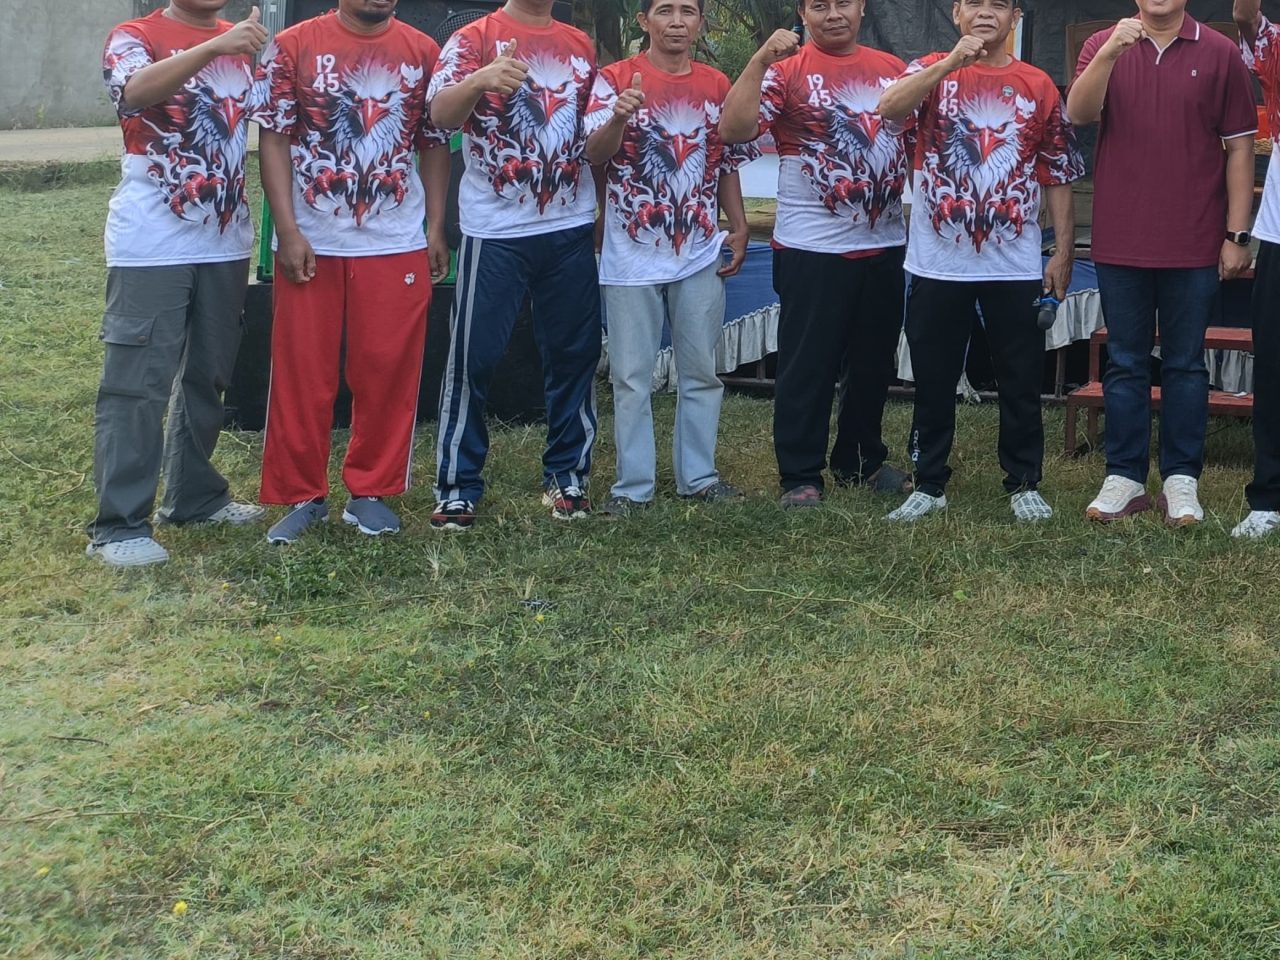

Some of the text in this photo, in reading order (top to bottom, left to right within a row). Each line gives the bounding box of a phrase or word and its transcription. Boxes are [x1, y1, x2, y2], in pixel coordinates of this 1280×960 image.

[316, 53, 336, 73] 19
[312, 73, 340, 93] 45
[806, 74, 824, 90] 19
[943, 80, 958, 98] 19
[808, 89, 832, 107] 45
[938, 97, 959, 116] 45
